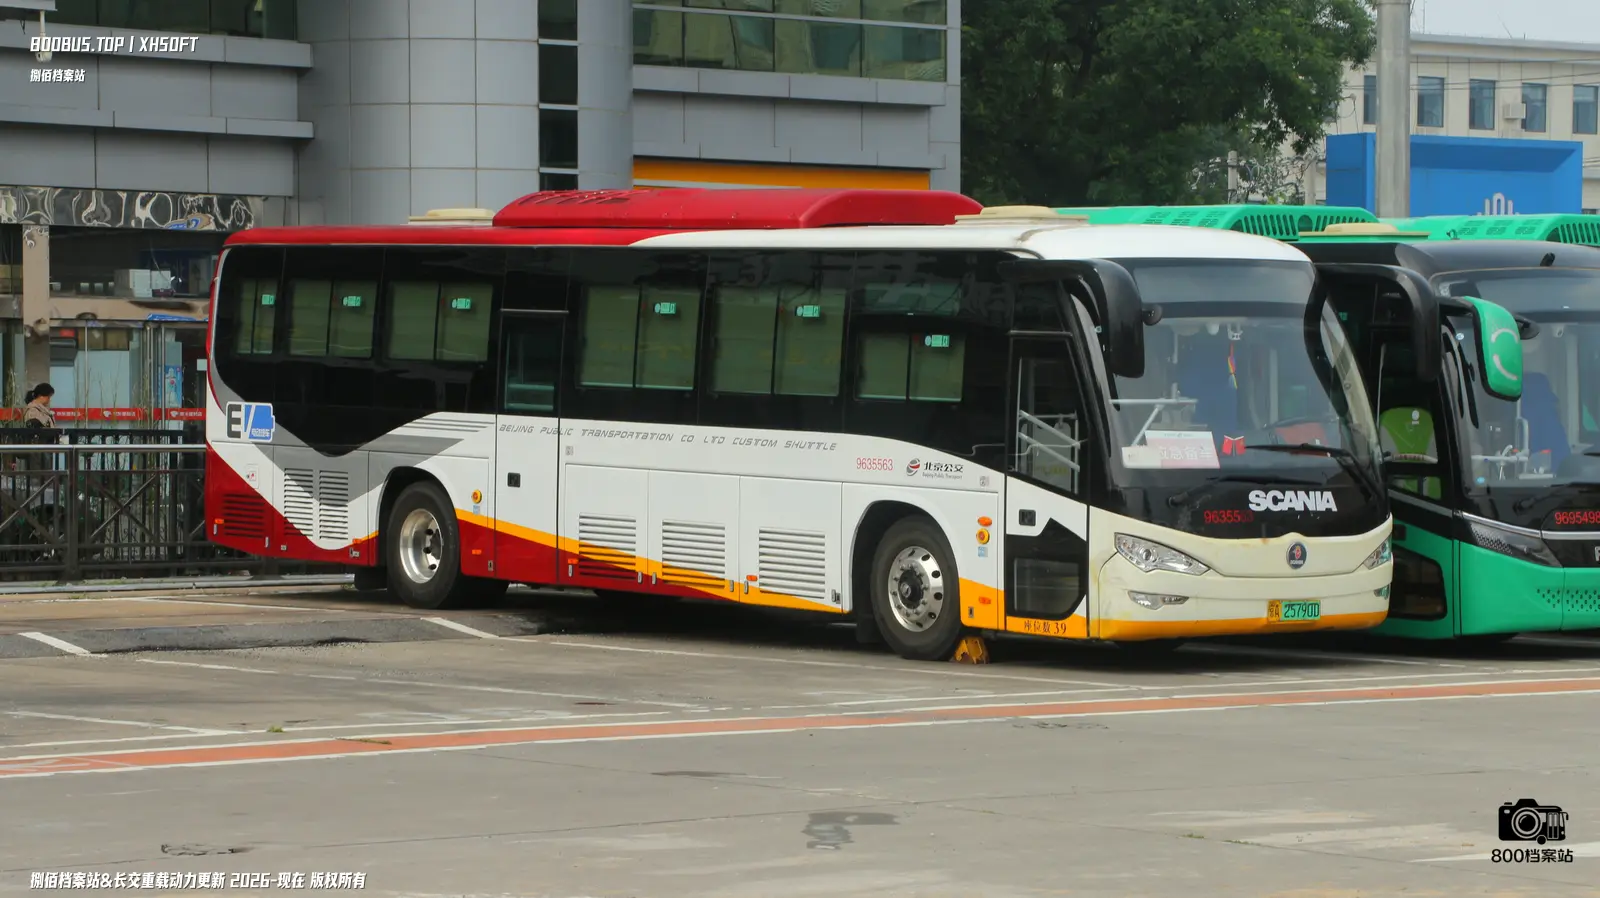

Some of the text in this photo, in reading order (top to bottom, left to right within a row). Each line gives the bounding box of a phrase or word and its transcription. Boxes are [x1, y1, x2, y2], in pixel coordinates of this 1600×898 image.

[499, 424, 837, 451] BEIJING PUBLIC TRANSPORTATION CO LTD CUSTOM SHUTTLE
[856, 457, 893, 471] 9635563
[924, 461, 964, 473] 北京公交
[1248, 489, 1338, 512] SCANIA
[1554, 511, 1600, 525] 9695498
[1024, 619, 1067, 634] 座位数 39
